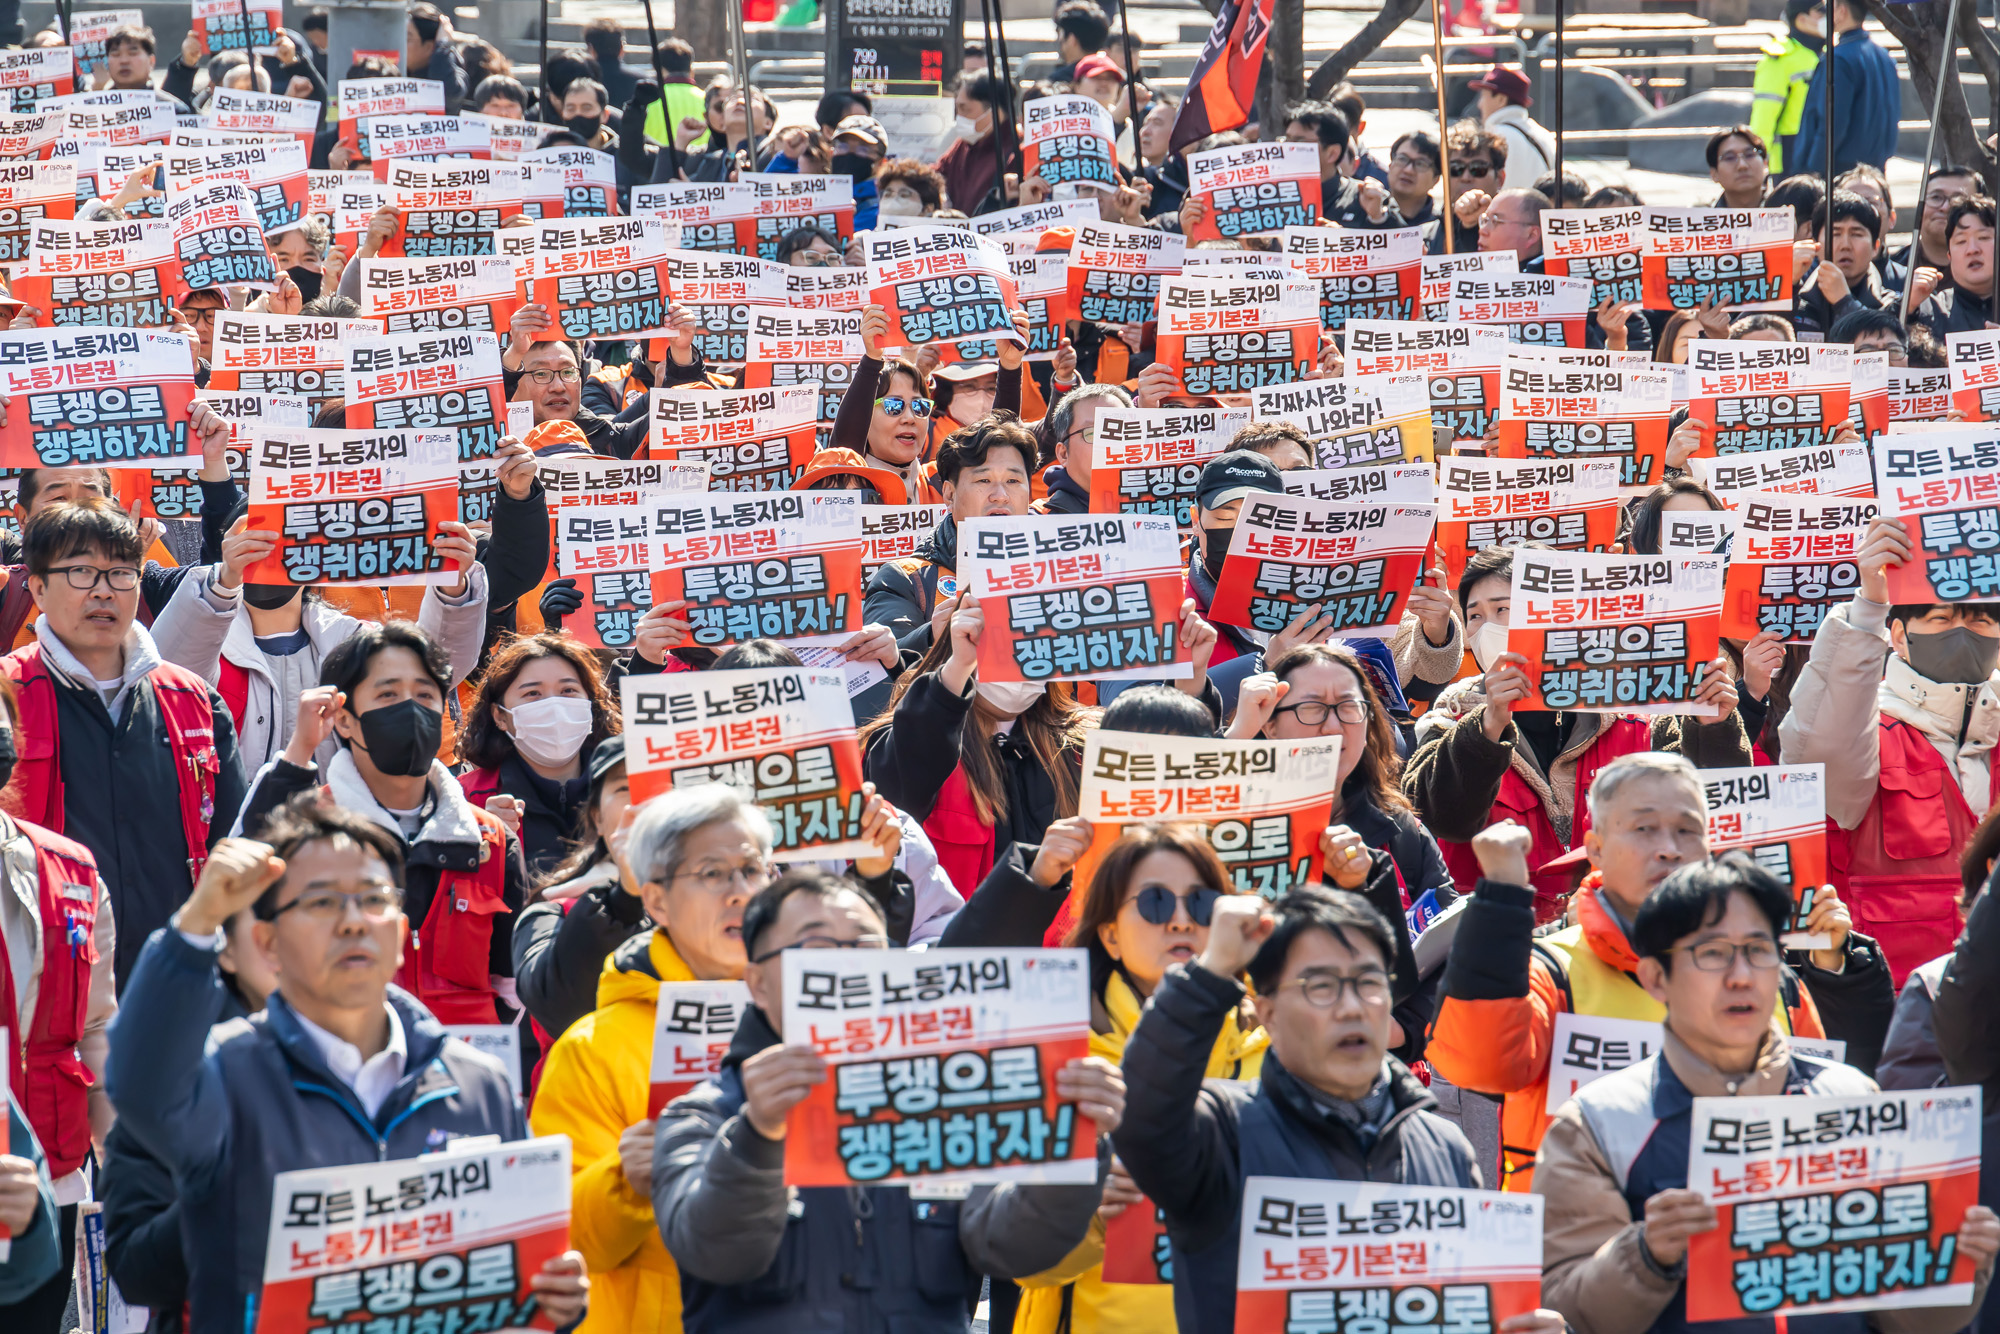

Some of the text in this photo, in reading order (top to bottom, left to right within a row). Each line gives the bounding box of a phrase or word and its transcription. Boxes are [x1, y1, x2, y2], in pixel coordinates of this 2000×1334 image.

[853, 48, 878, 65] 799
[853, 65, 889, 80] M7111
[216, 94, 292, 114] 모든 노동자의
[343, 82, 418, 99] 모든 노동자의
[217, 114, 275, 129] 노동기본권
[1194, 146, 1285, 174] 모든 노동자의
[393, 169, 489, 188] 모든 노동자의
[397, 190, 472, 207] 노동기본권
[1212, 182, 1300, 211] 투쟁으로
[35, 223, 142, 249] 모든 노동자의
[406, 210, 498, 235] 투쟁으로
[540, 219, 643, 250] 모든 노동자의
[1215, 204, 1315, 237] 쟁취하자!
[1648, 212, 1752, 234] 모든 노동자의
[871, 233, 978, 261] 모든 노동자의
[1079, 226, 1162, 250] 모든 노동자의
[1653, 233, 1733, 252] 노동기본권
[39, 249, 125, 274] 노동기본권
[369, 260, 477, 289] 모든 노동자의
[544, 246, 631, 274] 노동기본권
[879, 253, 969, 284] 노동기본권
[1079, 250, 1147, 269] 노동기본권
[1666, 252, 1766, 282] 투쟁으로
[52, 268, 161, 302] 투쟁으로
[373, 284, 457, 311] 노동기본권
[558, 266, 659, 305] 투쟁으로
[896, 274, 1004, 311] 투쟁으로
[1166, 282, 1281, 308] 모든 노동자의
[1455, 278, 1555, 299] 모든 노동자의
[53, 295, 174, 327] 쟁취하자!
[755, 315, 793, 337] 모든
[1170, 308, 1260, 331] 노동기본권
[1458, 302, 1540, 321] 노동기본권
[220, 321, 338, 343] 모든 노동자의
[1184, 332, 1293, 363] 투쟁으로
[2, 333, 139, 364] 모든 노동자의
[350, 335, 473, 372] 모든 노동자의
[759, 341, 844, 359] 노동기본권
[1696, 346, 1810, 370] 모든 노동자의
[8, 359, 118, 390] 노동기본권
[357, 365, 457, 398] 노동기본권
[1184, 362, 1309, 395] 쟁취하자!
[1506, 367, 1623, 394] 모든 노동자의
[1701, 372, 1790, 394] 노동기본권
[30, 386, 163, 425] 투쟁으로
[374, 389, 492, 429] 투쟁으로
[656, 391, 775, 421] 모든 노동자의
[1259, 383, 1347, 416] 진짜사장
[1512, 397, 1597, 417] 노동기본권
[1716, 394, 1822, 427] 투쟁으로
[662, 418, 755, 445] 노동기본권
[1101, 414, 1216, 441] 모든 노동자의
[1307, 397, 1384, 435] 나와라!
[34, 421, 185, 466] 쟁취하자!
[260, 434, 407, 469] 모든 노동자의
[1105, 439, 1196, 465] 노동기본권
[1526, 422, 1634, 452] 투쟁으로
[540, 464, 661, 491] 모든 노동자의
[1446, 463, 1574, 492] 모든 노동자의
[1886, 450, 1944, 478] 모든
[266, 468, 382, 498] 노동기본권
[1309, 470, 1387, 498] 노동자의
[284, 495, 424, 540] 투쟁으로
[655, 496, 804, 536] 모든 노동자의
[1246, 502, 1387, 533] 모든 노동자의
[1452, 492, 1550, 517] 노동기본권
[1743, 504, 1793, 531] 모든
[663, 529, 778, 564] 노동기본권
[977, 519, 1126, 559] 모든 노동자의
[1246, 533, 1356, 559] 노동기본권
[1747, 534, 1857, 560] 노동기본권
[683, 557, 825, 599] 투쟁으로
[986, 554, 1102, 589] 노동기본권
[1255, 558, 1385, 599] 투쟁으로
[1520, 560, 1673, 593] 모든 노동자의
[687, 594, 845, 640] 쟁취하자!
[1009, 582, 1151, 632] 투쟁으로
[1527, 593, 1643, 623] 노동기본권
[1014, 624, 1172, 678] 쟁취하자!
[1544, 623, 1686, 667] 투쟁으로
[634, 691, 697, 726] 모든
[702, 675, 805, 718] 노동자의
[645, 716, 782, 765] 노동기본권
[1094, 746, 1276, 782] 모든 노동자의
[1101, 785, 1242, 817] 노동기본권
[797, 958, 1010, 1010] 모든 노동자의
[809, 1007, 973, 1056] 노동기본권
[1562, 1032, 1630, 1071] 모든
[836, 1045, 1042, 1113] 투쟁으로
[840, 1104, 1072, 1180] 쟁취하자!
[1704, 1101, 1907, 1155] 모든 노동자의
[1712, 1146, 1868, 1198] 노동기본권
[284, 1159, 490, 1228] 모든 노동자의
[1254, 1197, 1466, 1238] 모든 노동자의
[1731, 1182, 1929, 1253] 투쟁으로
[290, 1210, 453, 1272] 노동기본권
[1263, 1243, 1429, 1282] 노동기본권
[1734, 1235, 1957, 1309] 쟁취하자!
[309, 1242, 517, 1318] 투쟁으로
